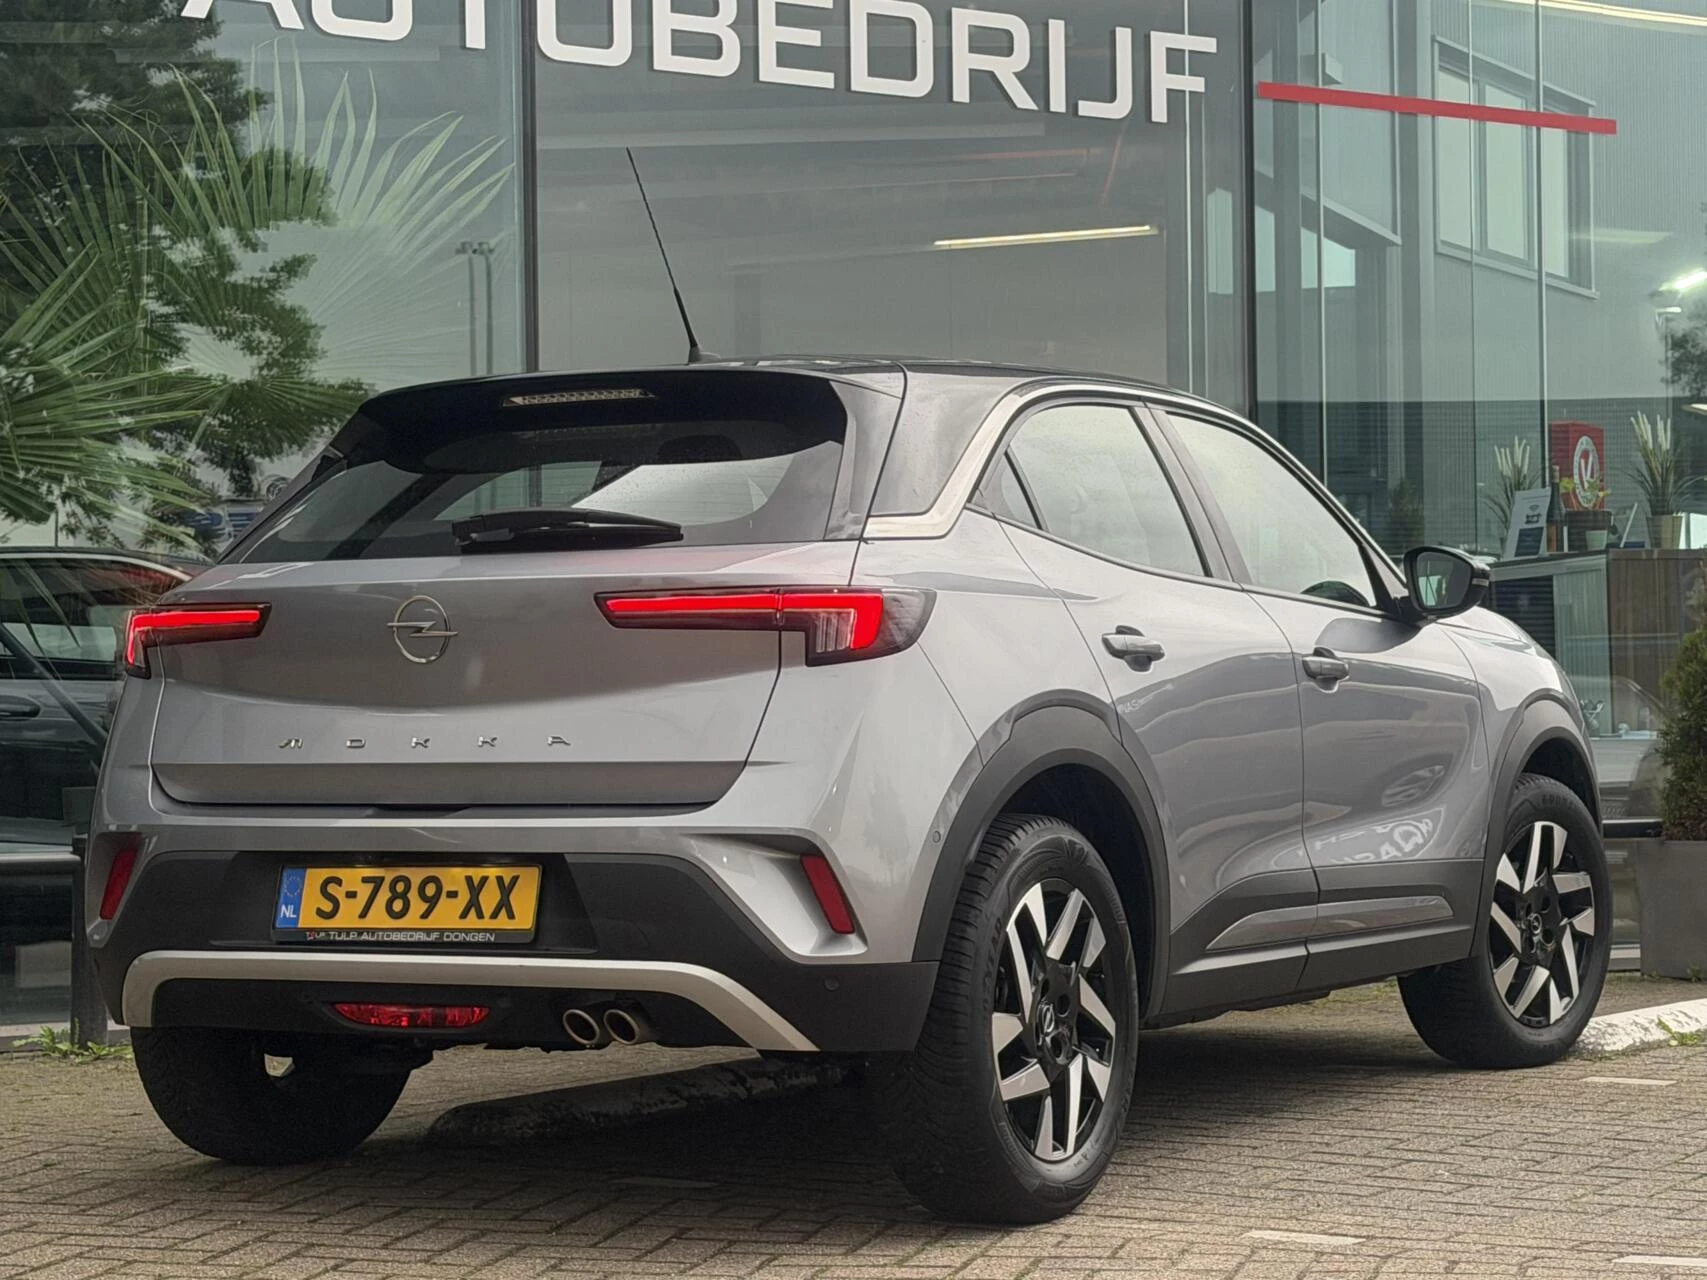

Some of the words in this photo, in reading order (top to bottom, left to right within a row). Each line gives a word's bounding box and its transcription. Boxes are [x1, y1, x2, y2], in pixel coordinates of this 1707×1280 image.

[181, 0, 1218, 124] OBEDRIJF
[279, 736, 572, 749] MOKKA
[315, 875, 521, 921] S-789-XX
[280, 904, 297, 918] NL
[328, 931, 358, 941] TULP
[360, 931, 441, 942] AUTOBEDRIJF
[443, 932, 496, 942] DONGEN
